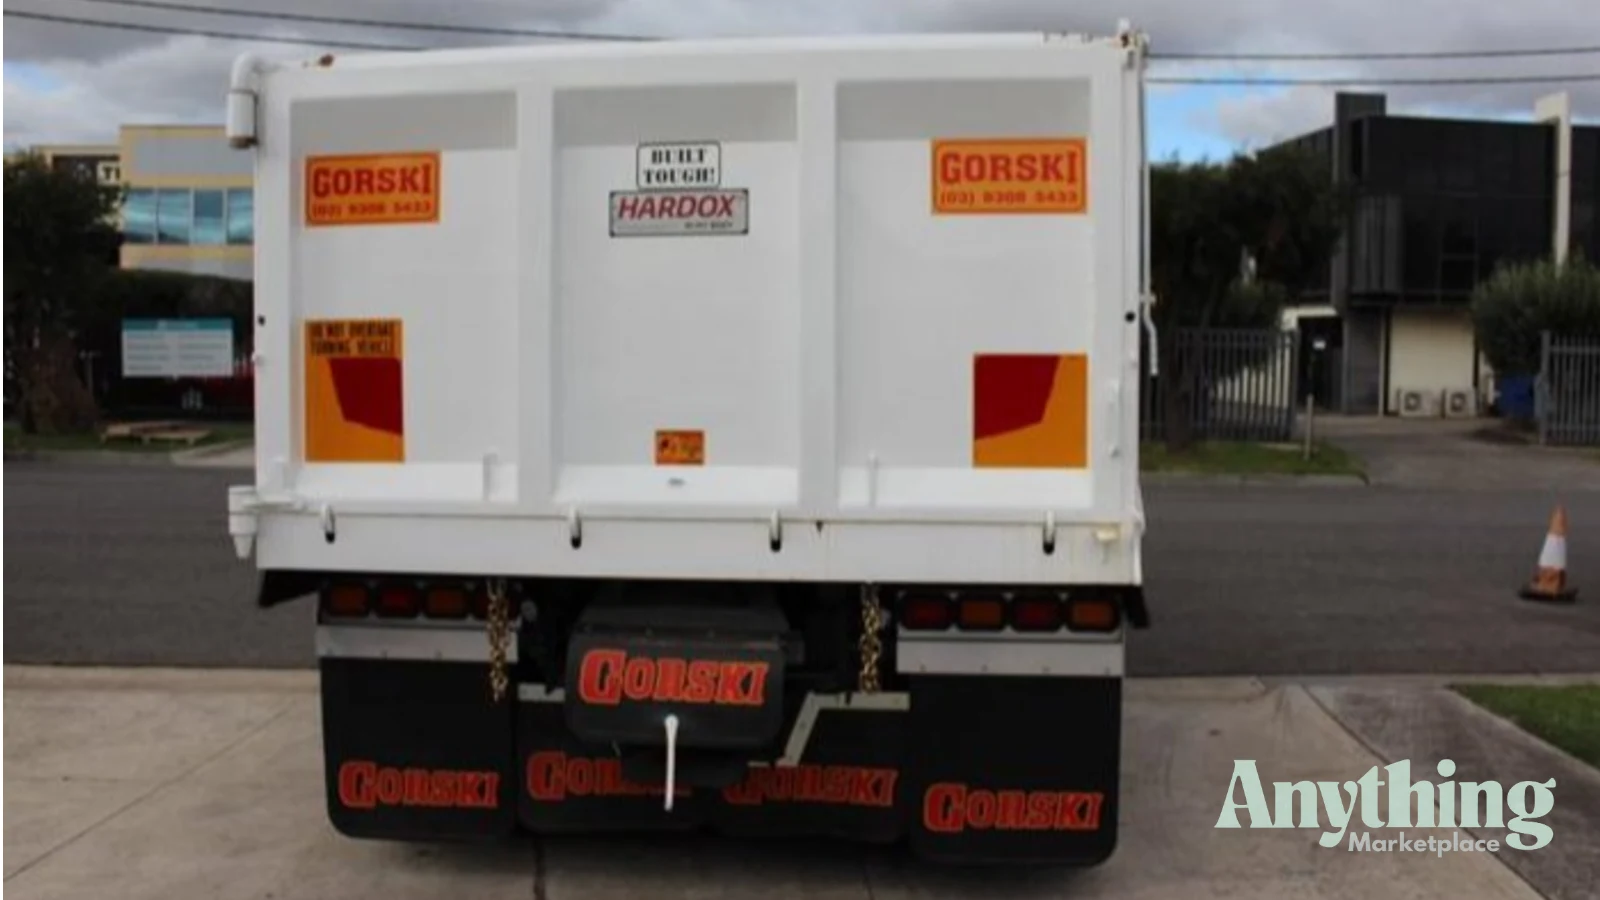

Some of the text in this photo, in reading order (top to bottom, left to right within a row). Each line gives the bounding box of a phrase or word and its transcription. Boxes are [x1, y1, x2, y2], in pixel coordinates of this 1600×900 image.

[651, 148, 706, 164] BUILT
[940, 151, 1077, 184] GORSKI
[313, 164, 431, 198] GORSKI
[643, 168, 715, 184] TOUGH!
[618, 195, 735, 220] HARDOX
[579, 648, 769, 706] GORSKI
[338, 760, 498, 808] GORSKI
[923, 782, 1103, 832] GORSKI
